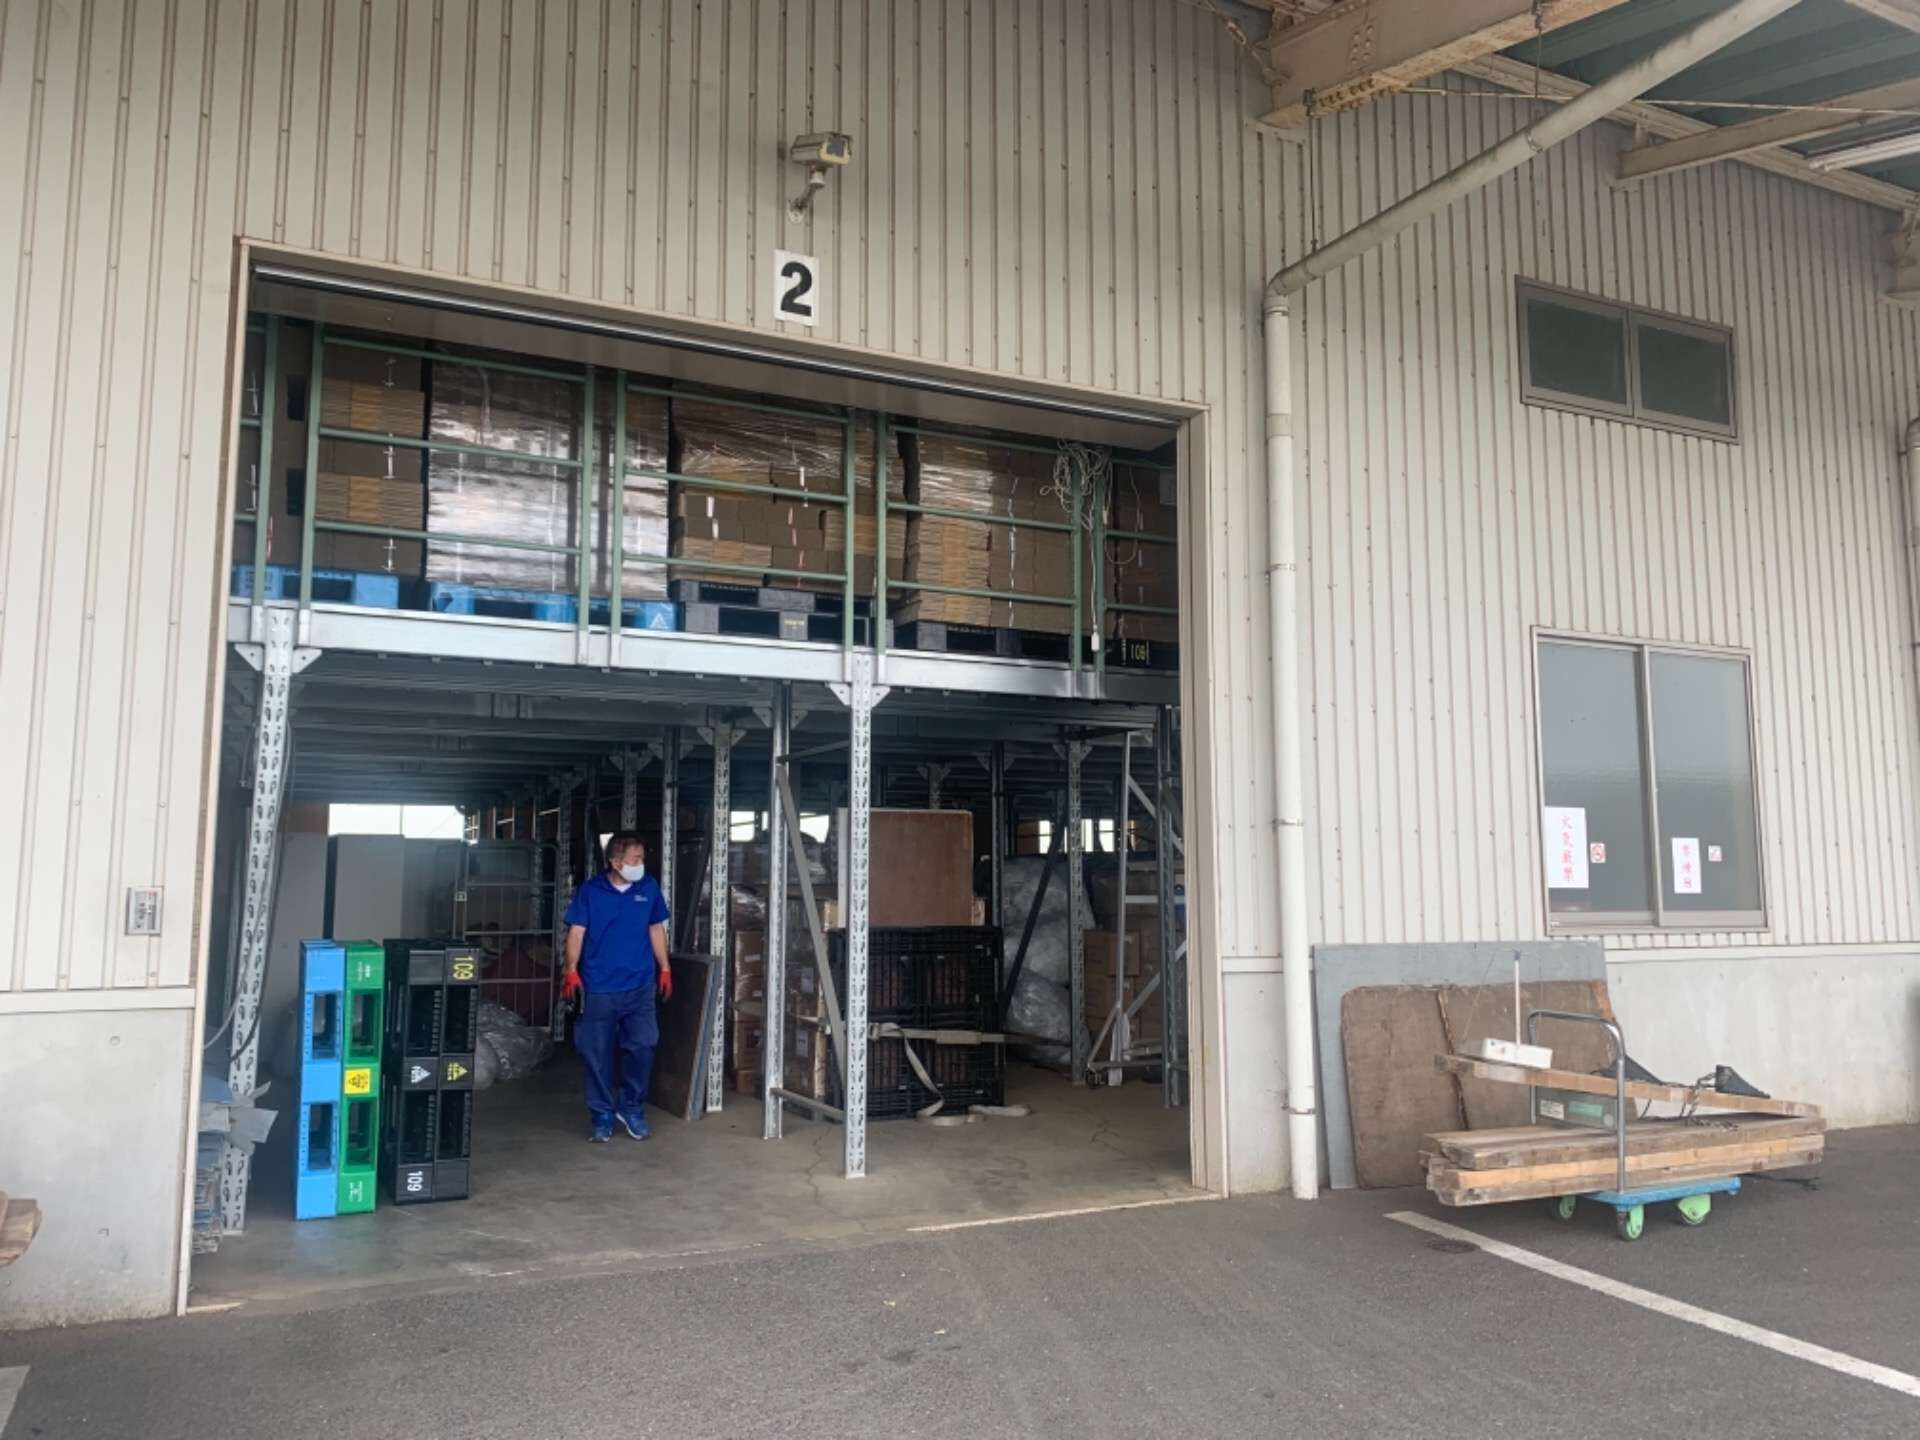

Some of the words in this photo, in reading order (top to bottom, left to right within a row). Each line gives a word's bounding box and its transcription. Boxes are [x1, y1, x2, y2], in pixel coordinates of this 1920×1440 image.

[780, 261, 812, 317] 2
[453, 956, 474, 980] 109
[407, 1171, 424, 1192] 109
